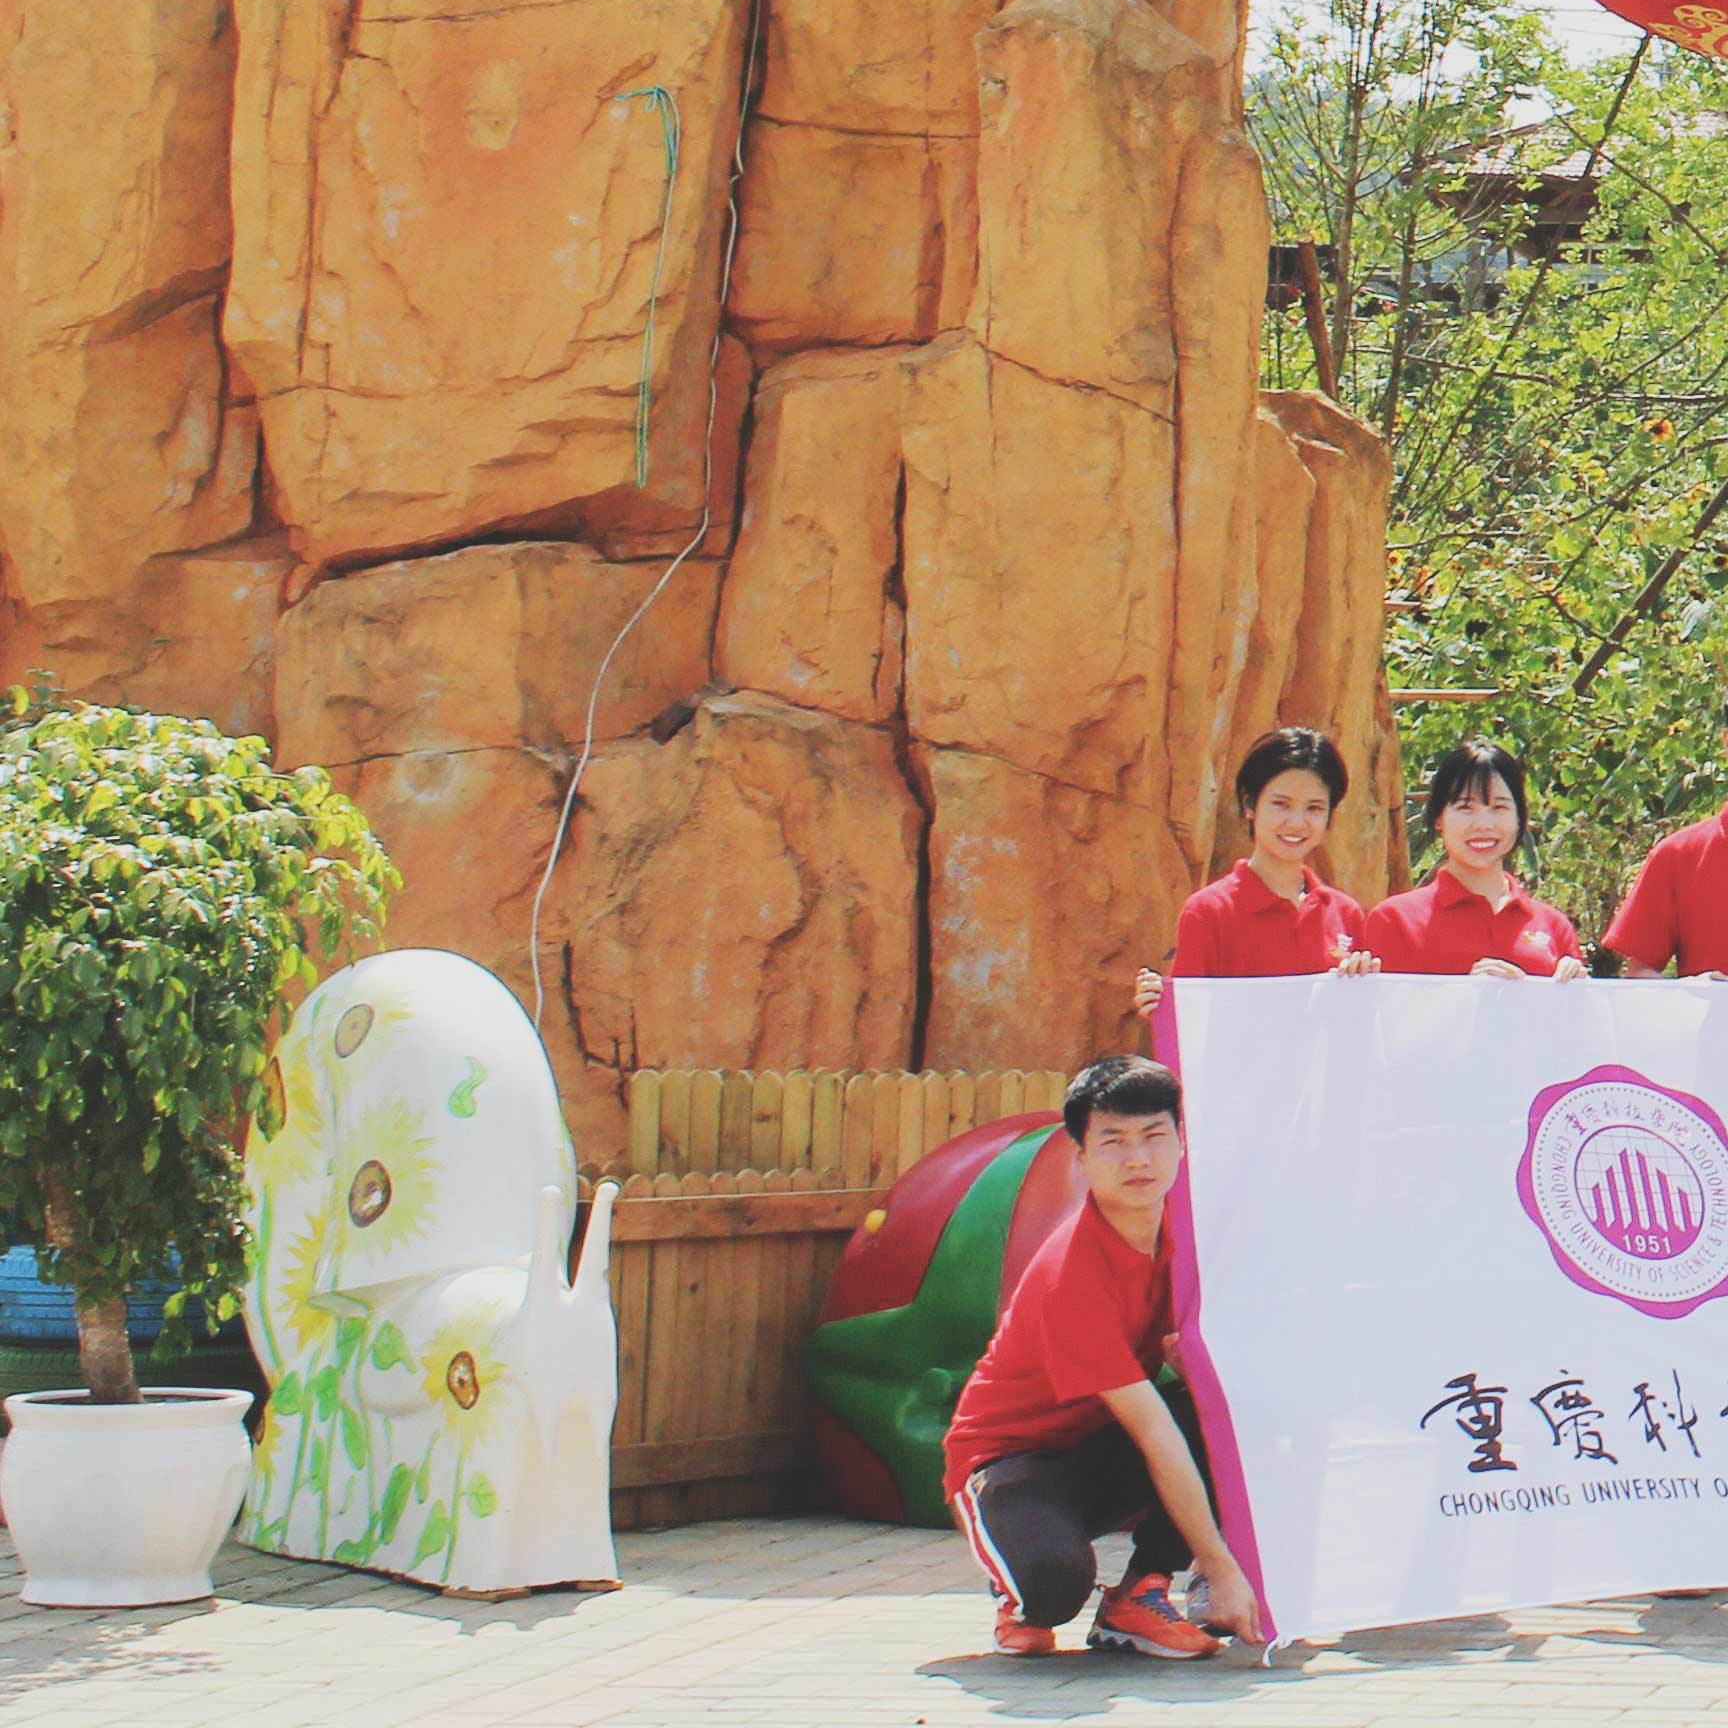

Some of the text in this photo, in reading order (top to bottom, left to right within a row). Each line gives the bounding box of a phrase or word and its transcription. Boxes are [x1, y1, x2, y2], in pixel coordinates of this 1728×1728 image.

[1550, 1135, 1577, 1221] CHONGQING
[1570, 1222, 1643, 1281] UNIVERSITY
[1648, 1266, 1665, 1283] OF
[1670, 1243, 1713, 1282] SCIENCE
[1622, 1233, 1673, 1255] 1951
[1439, 1483, 1571, 1518] CHONGQING
[1583, 1475, 1701, 1504] UNIVERSITY
